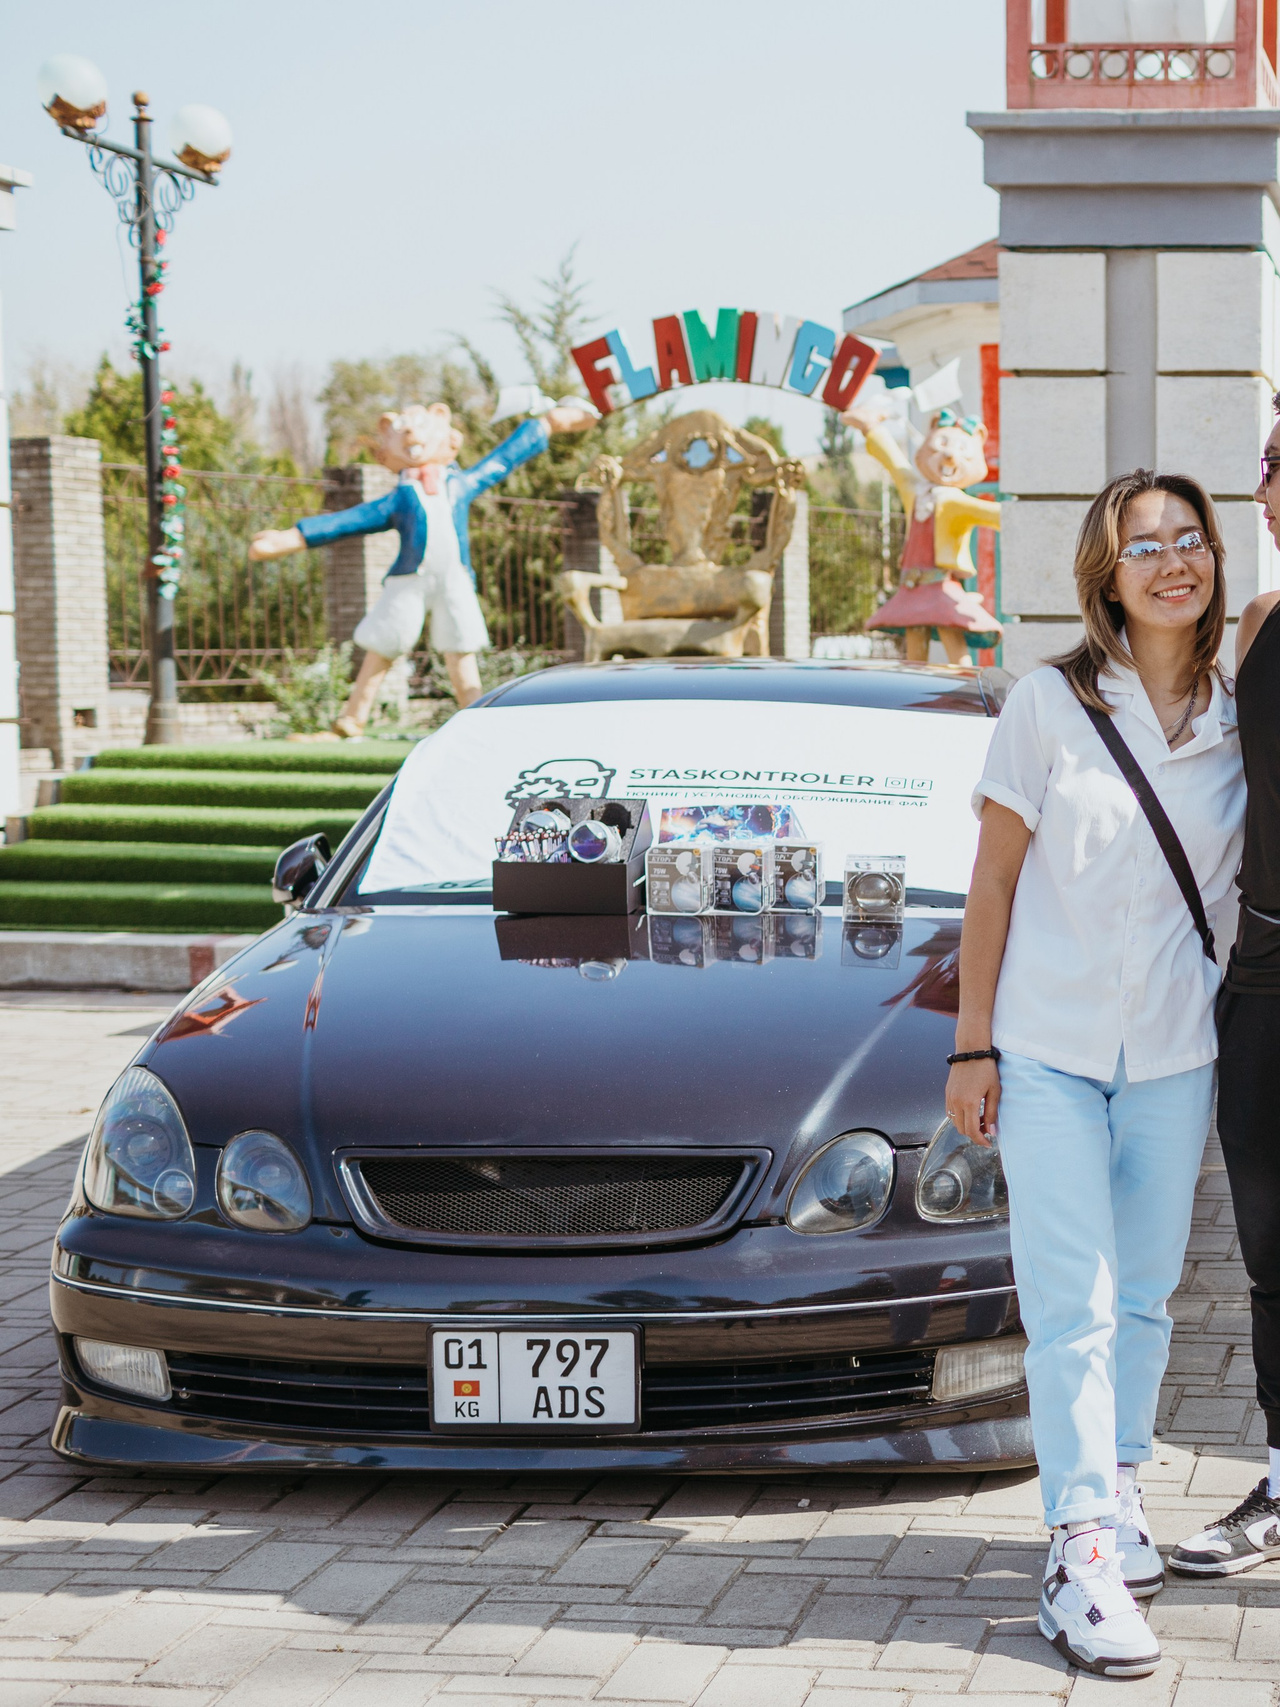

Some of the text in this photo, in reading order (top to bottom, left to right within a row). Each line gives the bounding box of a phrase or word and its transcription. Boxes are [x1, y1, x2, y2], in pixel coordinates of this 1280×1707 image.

[570, 308, 882, 416] FLAMINGO
[629, 768, 875, 787] STASKONTROLER
[692, 791, 771, 799] УСТАНОВКА
[444, 1338, 487, 1369] 01
[526, 1339, 609, 1378] 797
[455, 1401, 480, 1418] KG
[532, 1386, 606, 1418] ADS
